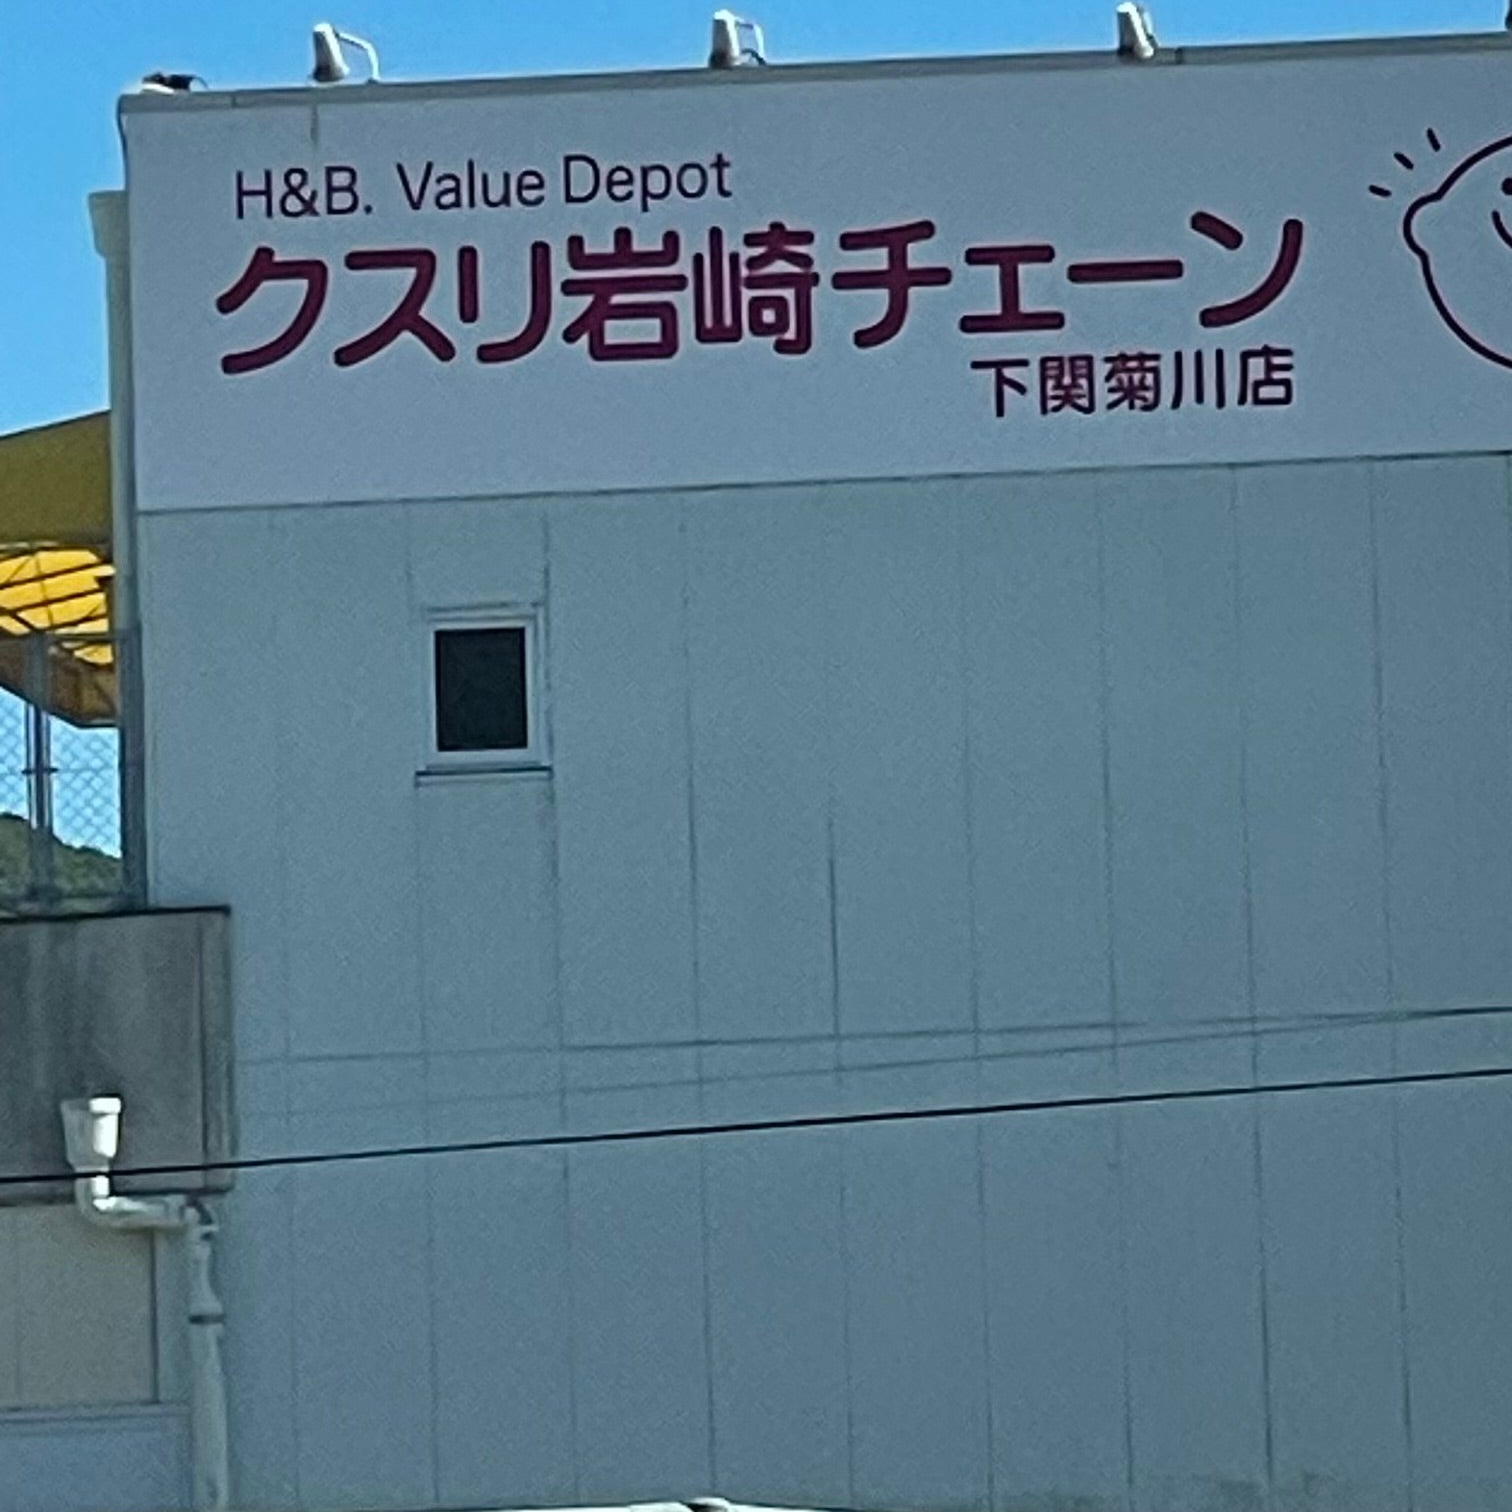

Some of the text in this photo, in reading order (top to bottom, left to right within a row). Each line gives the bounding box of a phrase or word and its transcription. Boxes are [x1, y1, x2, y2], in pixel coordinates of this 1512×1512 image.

[235, 152, 733, 219] H&B. Value Depot
[215, 210, 1304, 374] クスリ岩崎チェーン
[970, 345, 1294, 418] 下関菊川店
